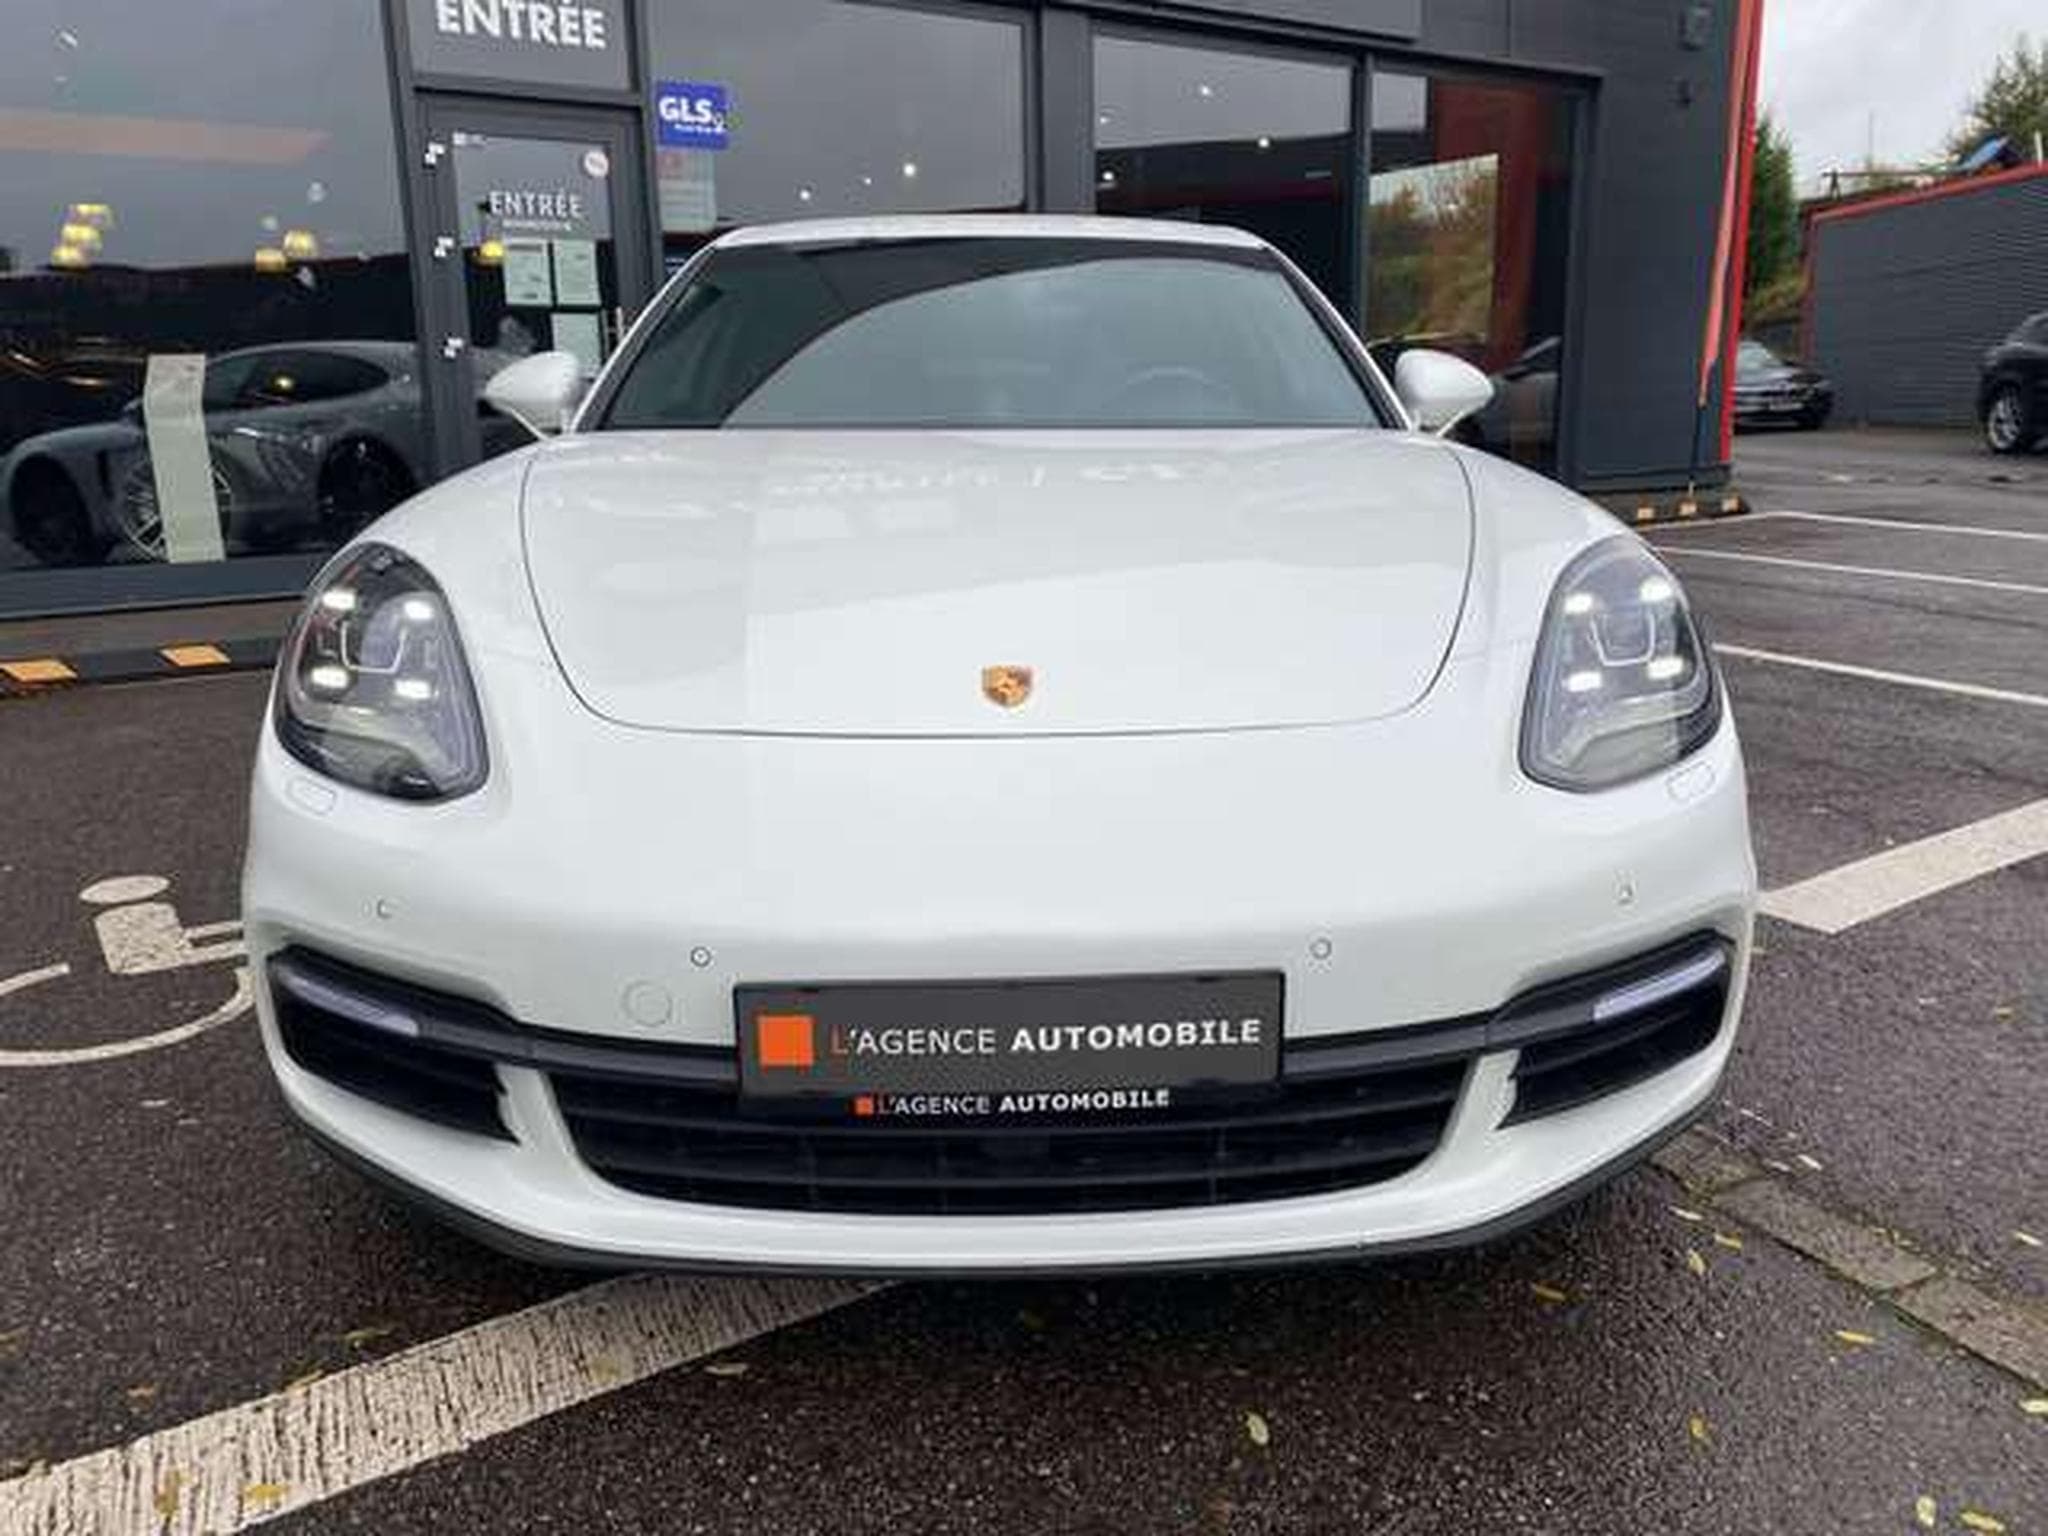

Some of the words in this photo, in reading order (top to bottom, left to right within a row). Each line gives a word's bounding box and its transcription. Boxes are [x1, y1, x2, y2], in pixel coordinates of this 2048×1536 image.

[434, 0, 606, 48] ENTRÉE
[489, 187, 581, 219] ENTRÉE
[830, 1027, 996, 1056] L'AGENCE
[1010, 1018, 1262, 1052] AUTOMOBILE
[878, 1095, 991, 1115] L'AGENCE
[999, 1088, 1170, 1113] AUTOMOBILE
